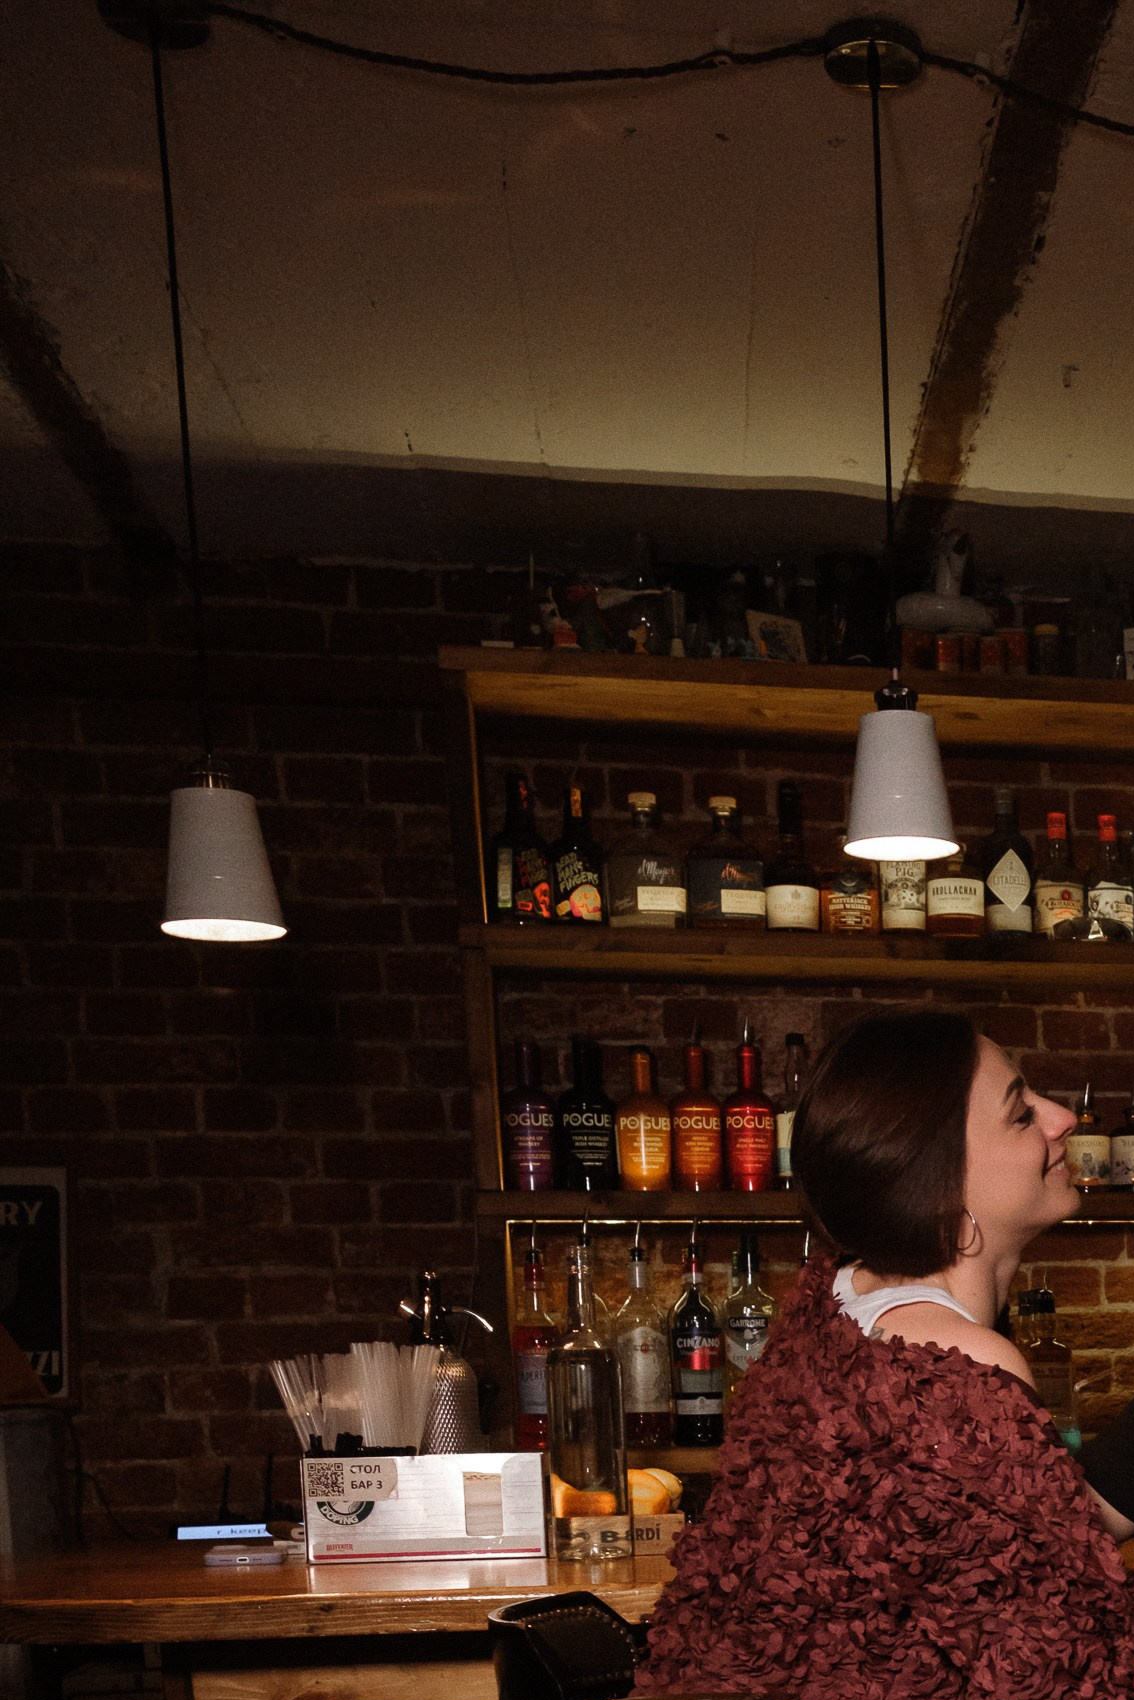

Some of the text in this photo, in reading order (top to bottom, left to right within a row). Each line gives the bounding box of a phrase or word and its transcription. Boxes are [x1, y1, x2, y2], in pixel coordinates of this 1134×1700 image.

[895, 867, 914, 877] PIG
[726, 1115, 774, 1130] POGUES
[729, 1318, 767, 1328] GARRONE
[676, 1336, 720, 1349] CINZANO
[350, 1464, 381, 1474] СТОЛ
[351, 1480, 384, 1490] БАР 3
[319, 1505, 360, 1525] DOPING
